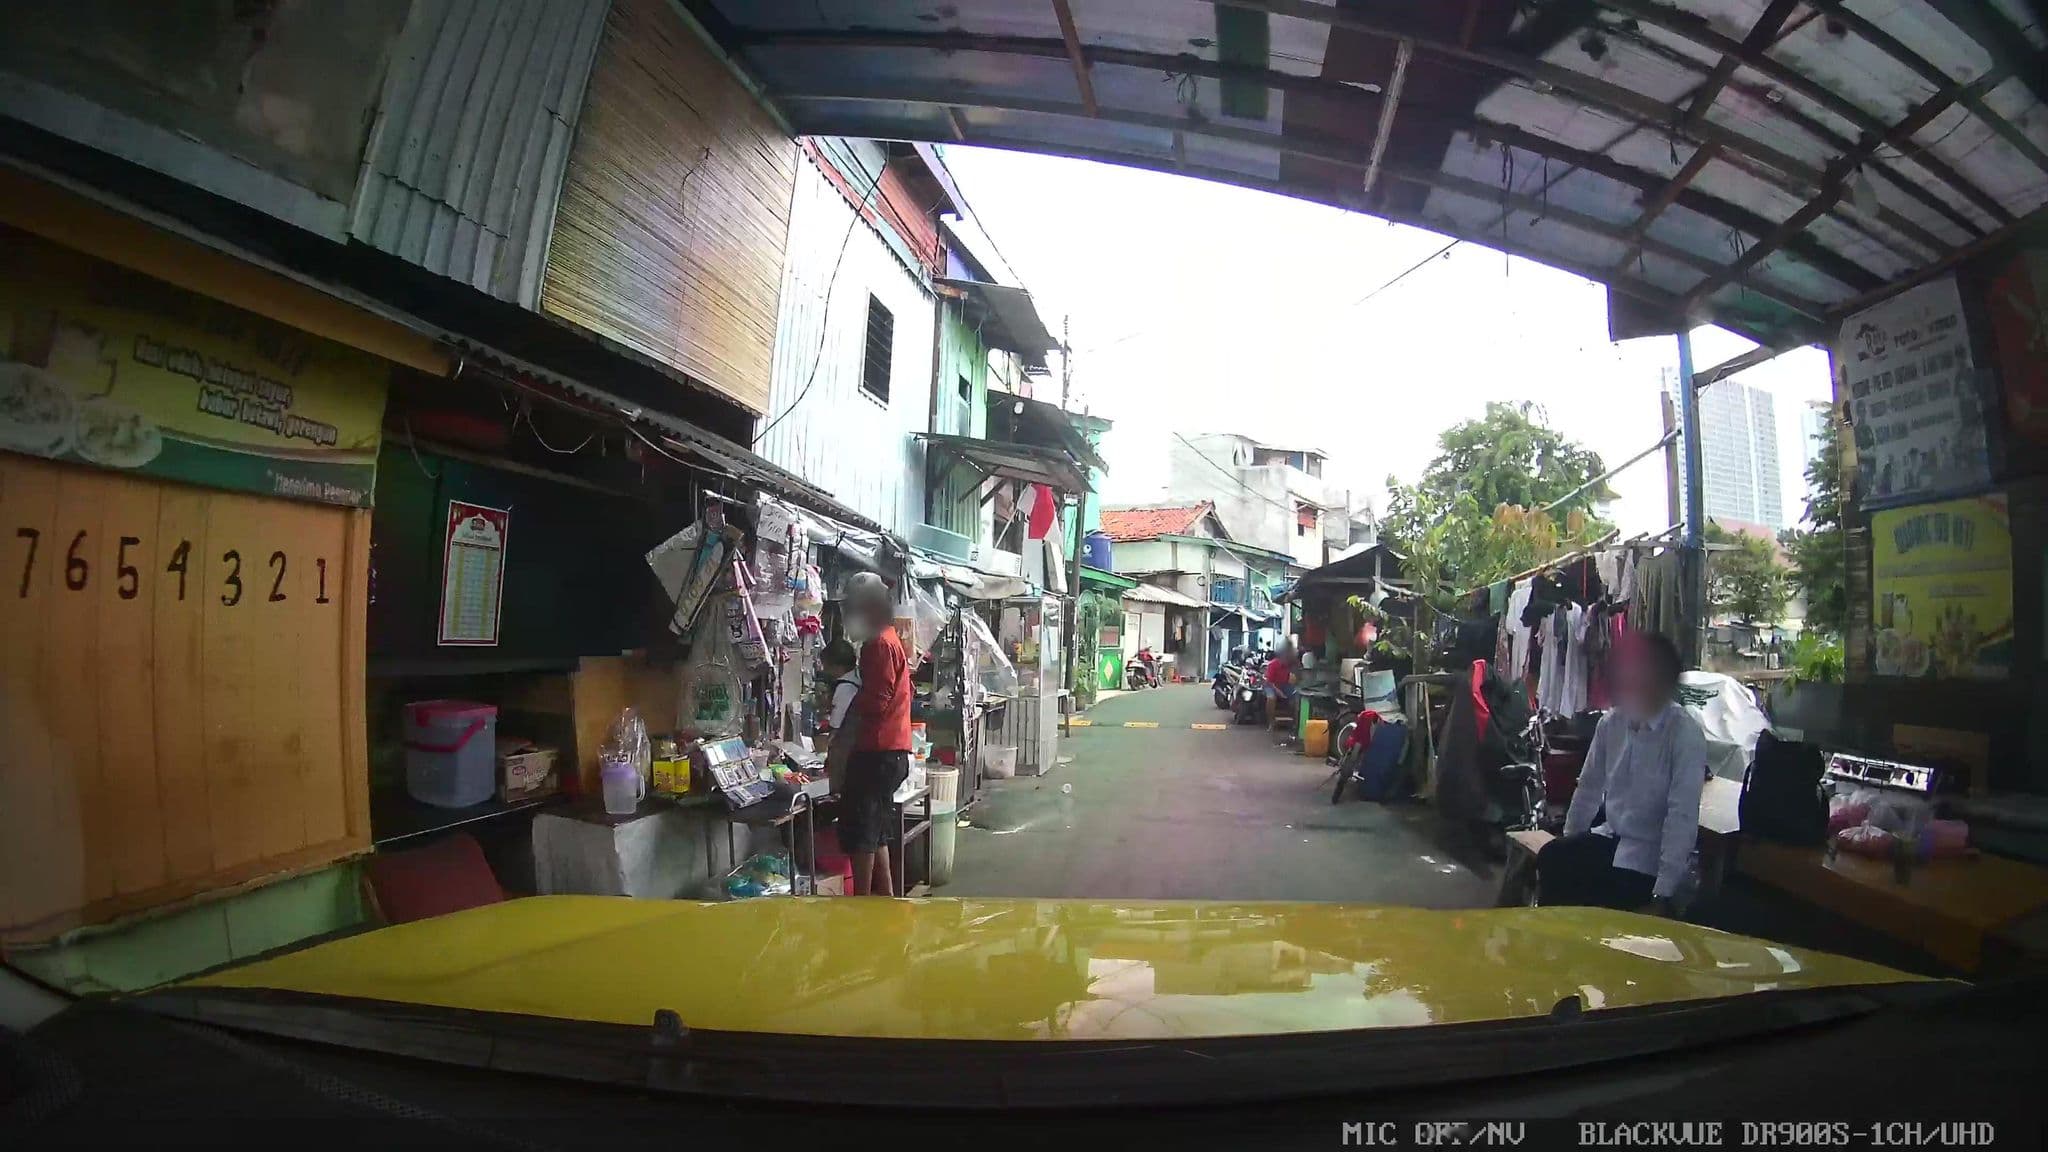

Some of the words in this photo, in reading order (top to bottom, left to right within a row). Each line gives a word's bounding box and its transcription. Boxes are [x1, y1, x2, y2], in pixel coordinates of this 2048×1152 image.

[17, 528, 40, 598] 7
[65, 530, 88, 591] 6
[117, 536, 140, 600] 5
[167, 540, 191, 601] 4
[221, 550, 242, 606] 3
[269, 550, 287, 602] 2
[315, 558, 329, 604] 1
